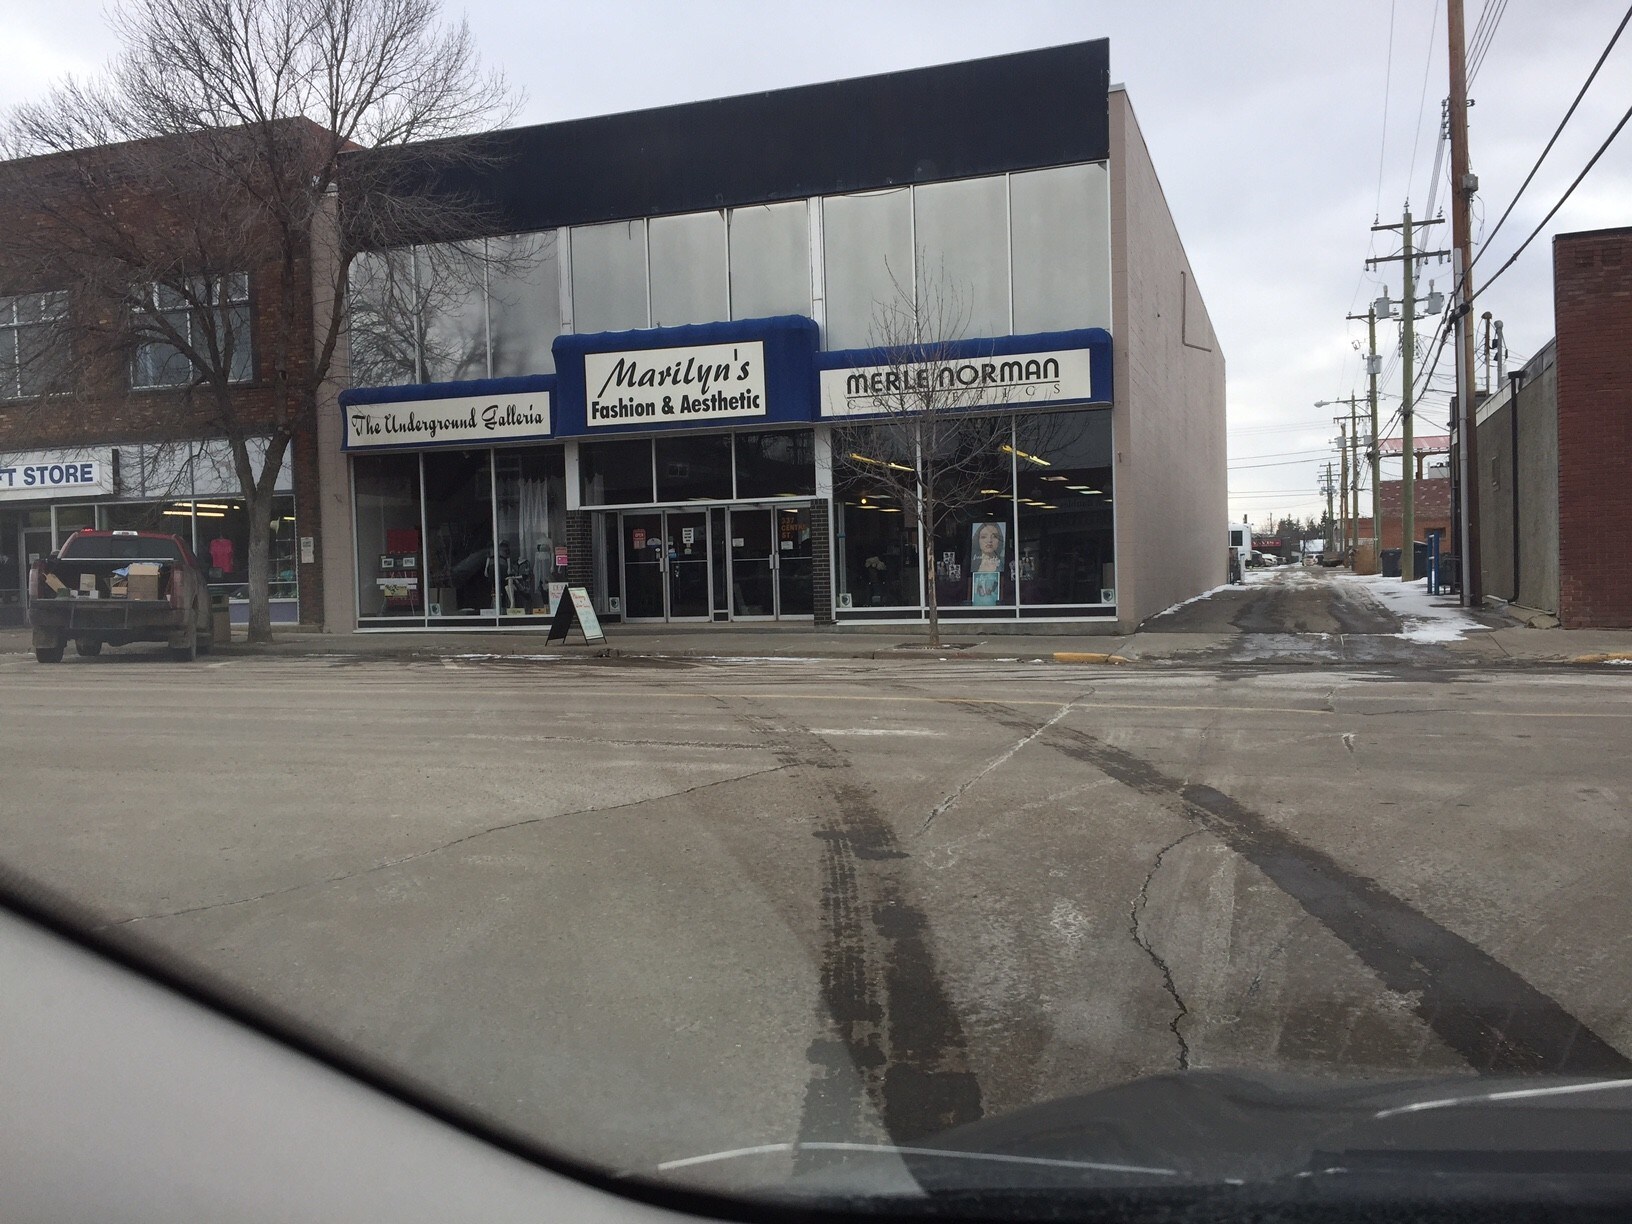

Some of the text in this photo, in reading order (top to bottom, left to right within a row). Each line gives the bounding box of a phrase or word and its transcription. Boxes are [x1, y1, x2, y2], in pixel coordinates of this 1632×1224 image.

[597, 348, 750, 399] Marilyn's
[846, 357, 1060, 394] MERLE NORMAN
[591, 388, 760, 420] Fashion & Aesthetic
[846, 383, 1061, 410] COSETICS
[351, 404, 545, 438] The Underground Galleria
[0, 463, 94, 487] T STORE
